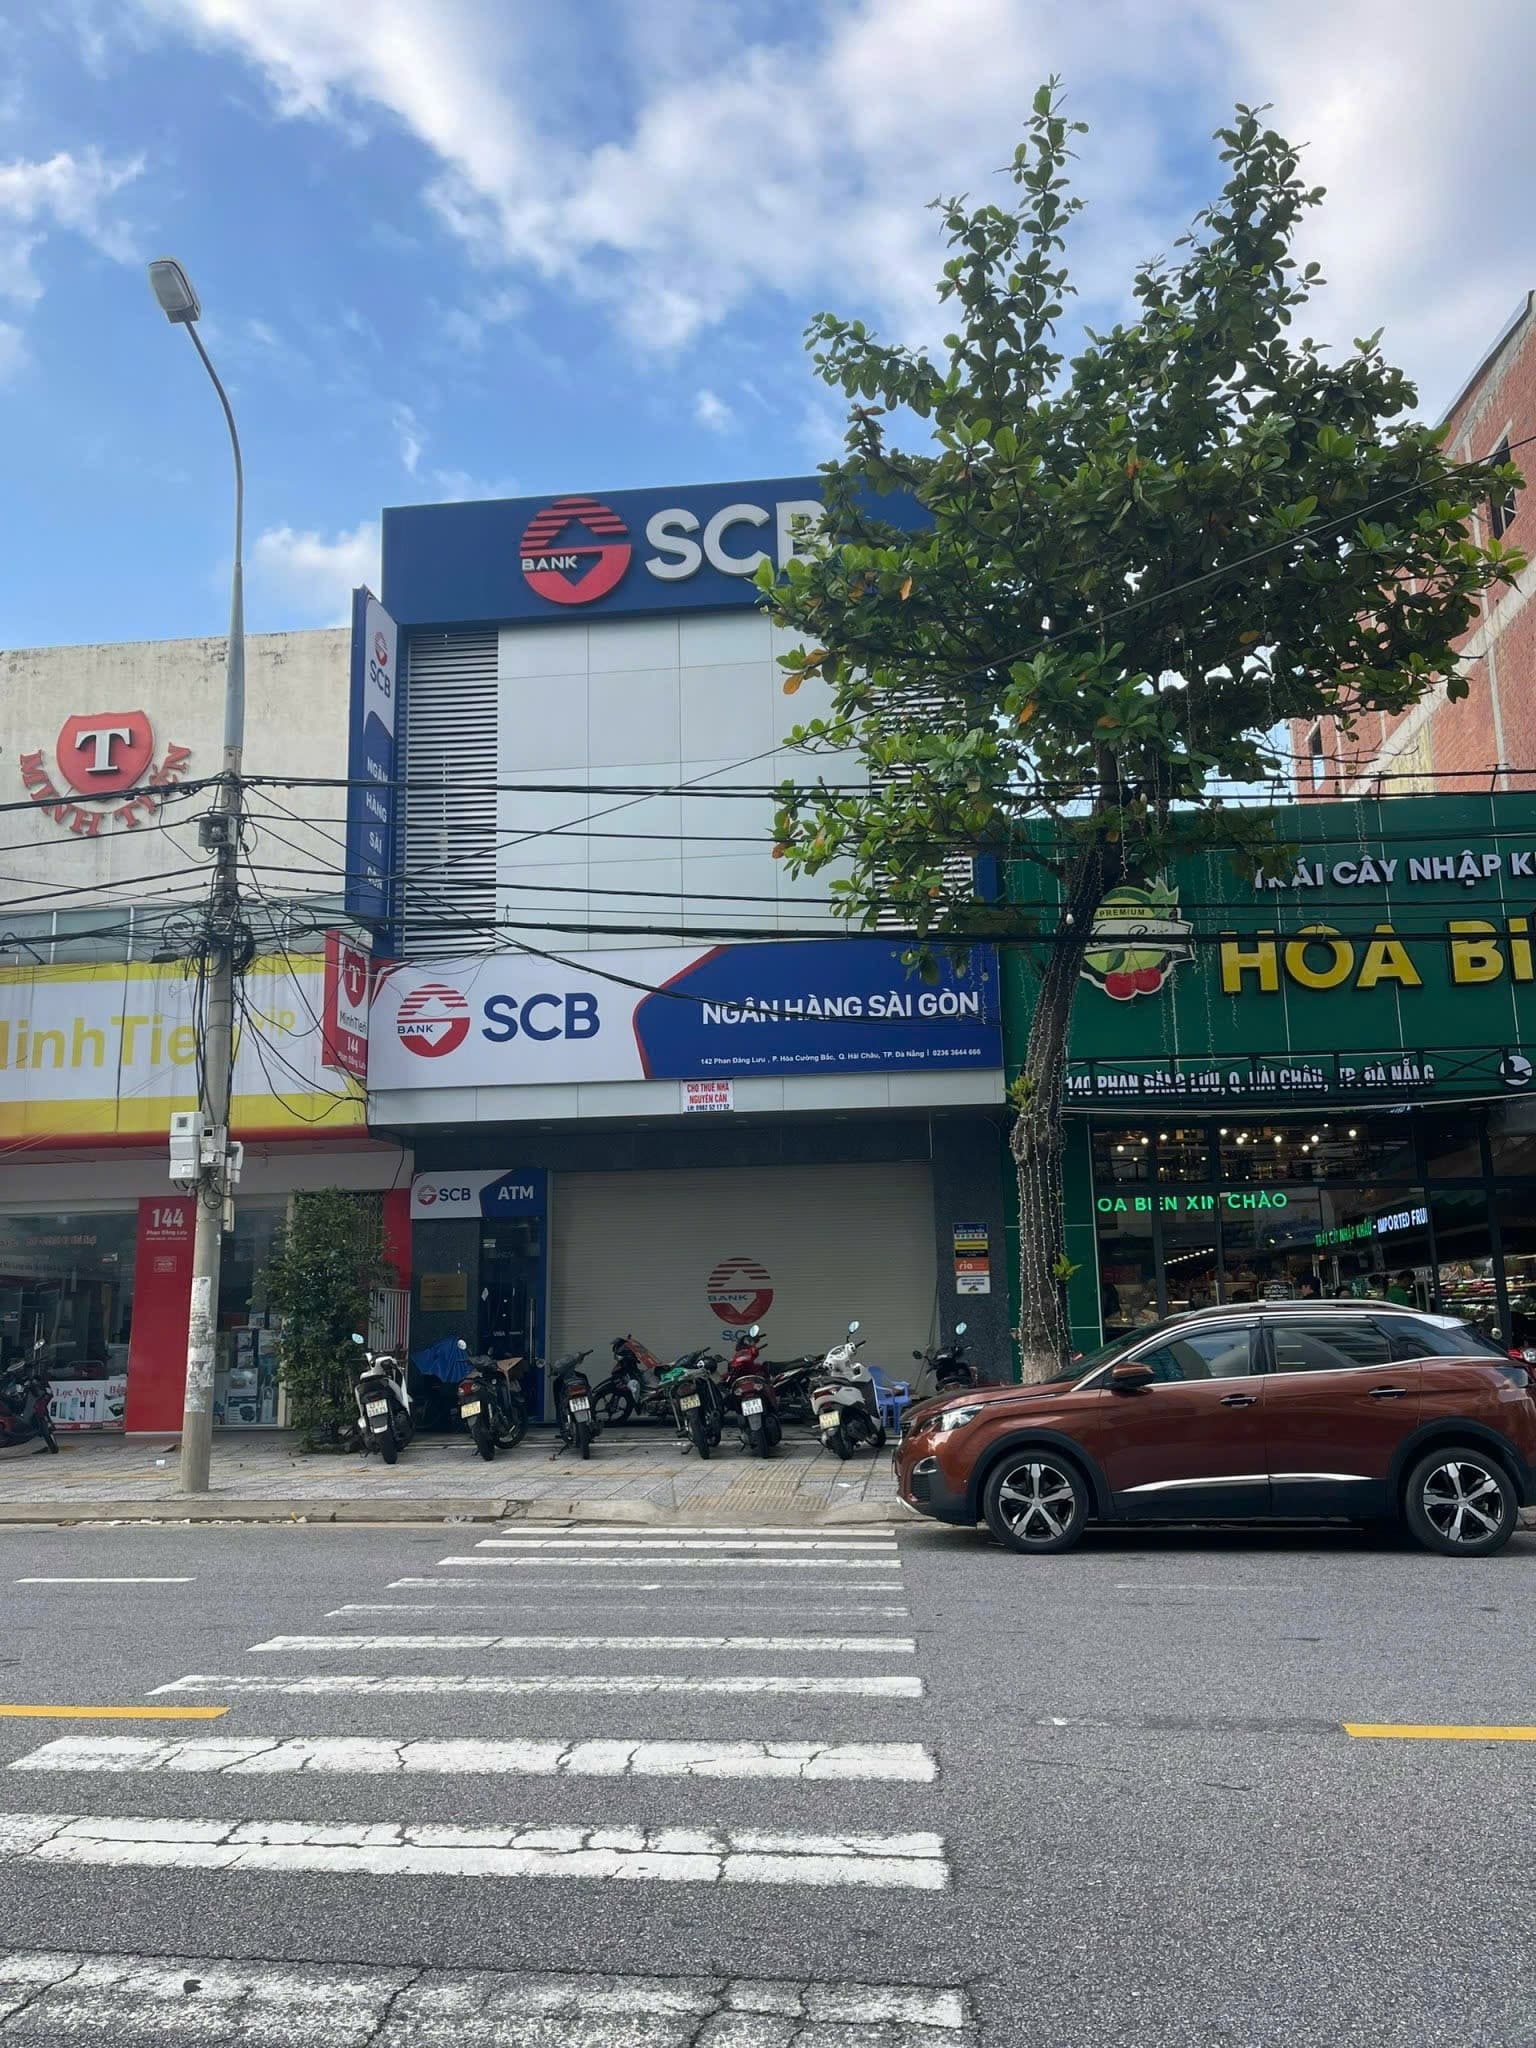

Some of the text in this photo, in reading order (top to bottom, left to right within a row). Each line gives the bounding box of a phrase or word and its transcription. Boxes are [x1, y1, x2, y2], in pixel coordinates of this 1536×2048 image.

[644, 499, 832, 581] SCB
[521, 555, 579, 571] BANK
[369, 659, 391, 698] SCB
[74, 727, 131, 772] T
[20, 749, 104, 835] MINH
[366, 792, 387, 824] HÀNG
[369, 831, 382, 854] SÀI
[1254, 849, 1536, 889] ÁI CÂY NHẬP K
[1099, 908, 1145, 918] PREMIUM
[1220, 923, 1422, 993] HOA
[702, 987, 979, 1024] NGÂN HÀNG SÀI GÒN
[481, 992, 600, 1042] SCB
[397, 1024, 434, 1034] BANK
[0, 1016, 238, 1070] inhTie
[347, 1037, 358, 1054] 144
[687, 1083, 699, 1093] CHO
[1097, 1075, 1139, 1095] PHAN
[439, 1185, 534, 1202] SCB ATM
[1227, 1190, 1287, 1209] CHÀO
[152, 1208, 184, 1228] 144
[1377, 1211, 1410, 1233] IMPORTED
[707, 1294, 748, 1302] BANK
[721, 1329, 750, 1341] SC
